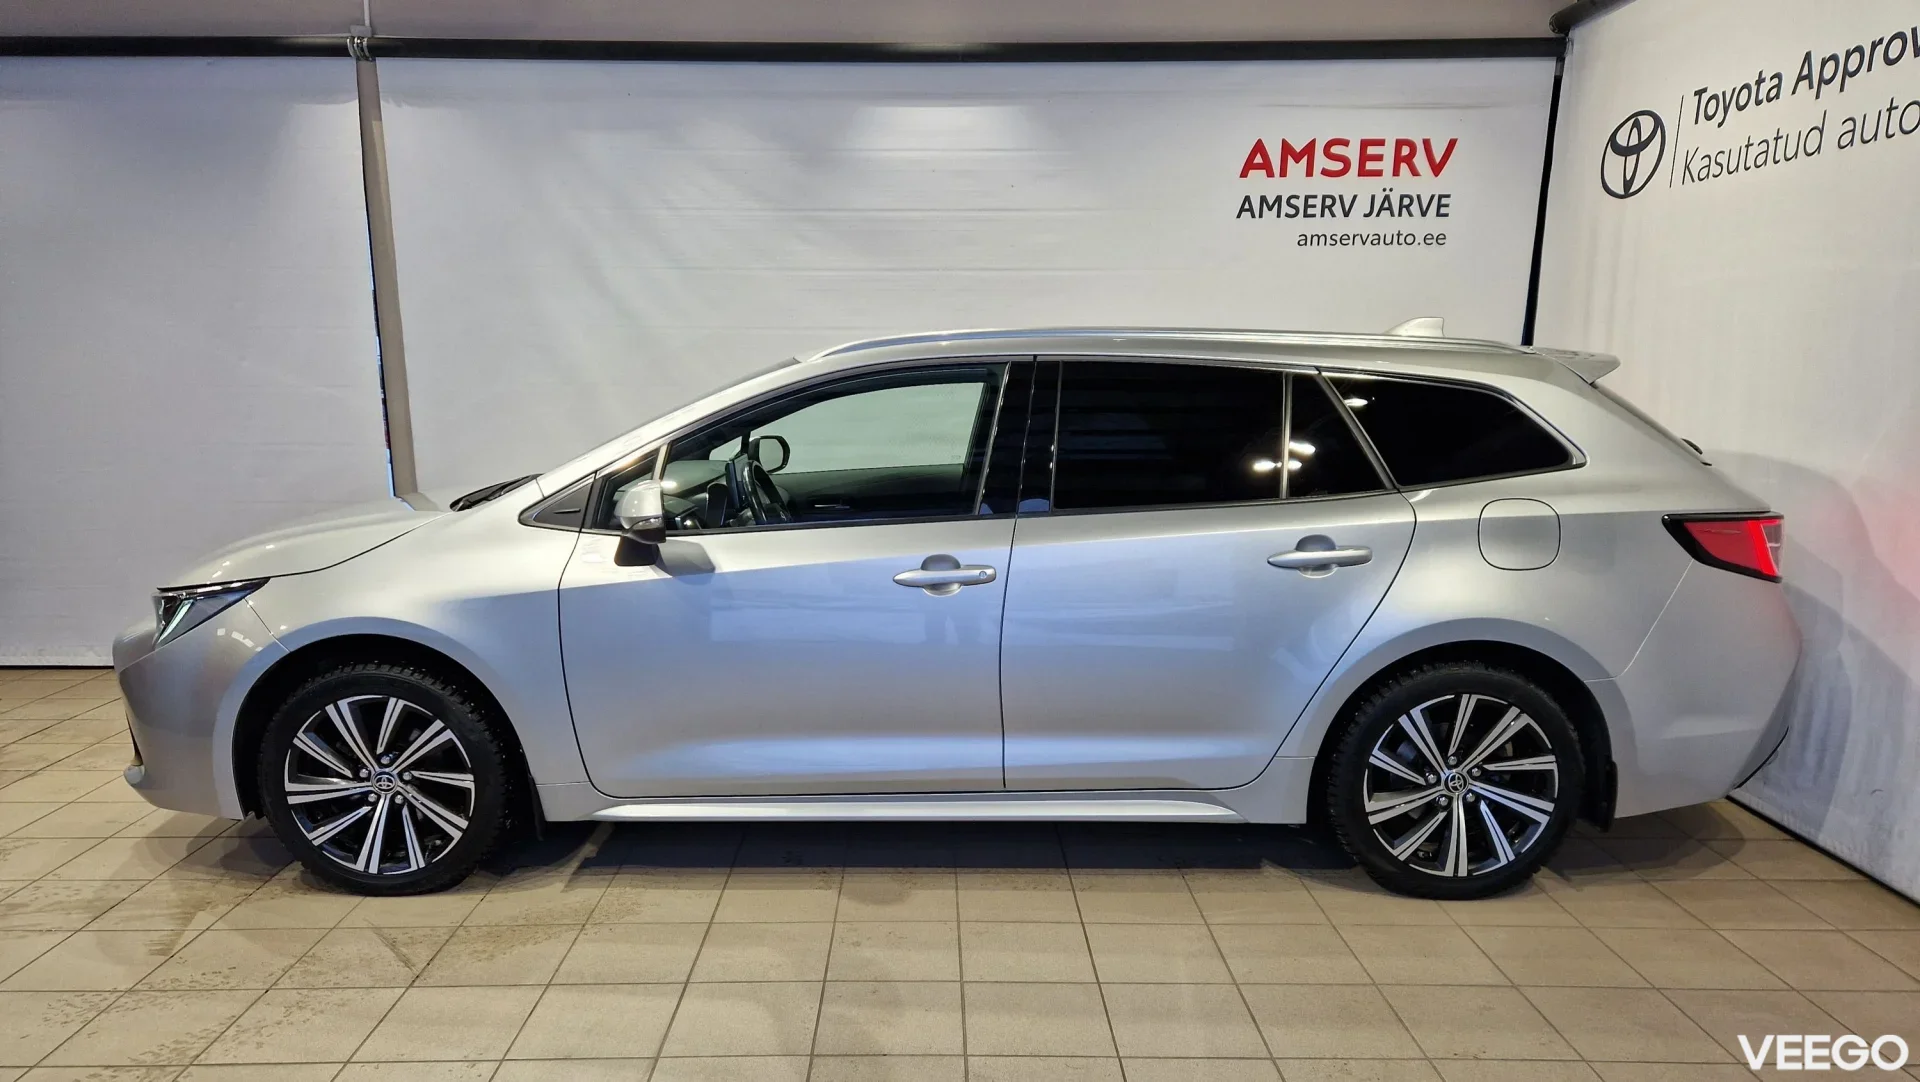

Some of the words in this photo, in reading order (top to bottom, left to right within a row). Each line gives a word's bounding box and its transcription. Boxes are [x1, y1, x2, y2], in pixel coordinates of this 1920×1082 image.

[1693, 70, 1783, 128] Toyota
[1239, 137, 1459, 178] AMSERV
[1682, 110, 1827, 185] Kasutatud
[1837, 97, 1920, 149] auto
[1236, 194, 1358, 219] AMSERV
[1363, 187, 1451, 218] JÄRVE
[1297, 230, 1447, 246] amservauto.ee
